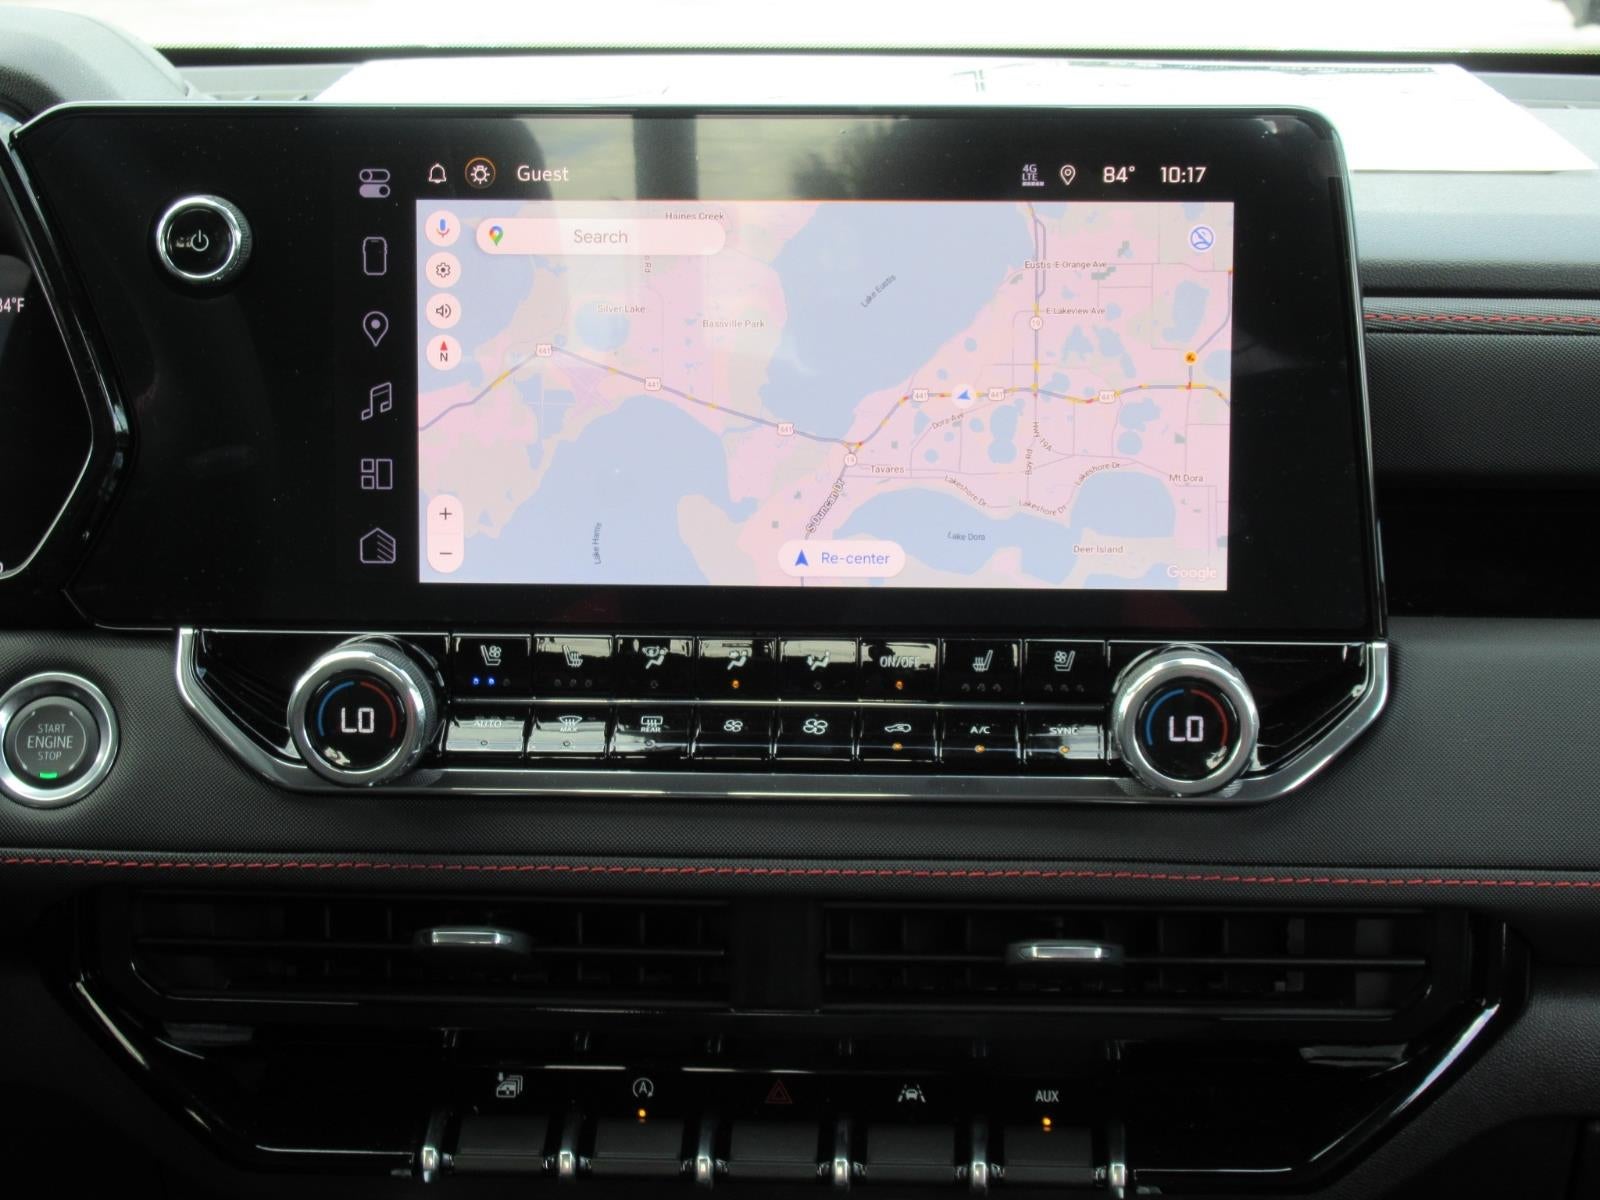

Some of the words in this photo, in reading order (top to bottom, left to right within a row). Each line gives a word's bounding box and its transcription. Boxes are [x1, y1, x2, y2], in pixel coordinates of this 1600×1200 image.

[516, 165, 569, 183] Guest
[1022, 164, 1037, 173] 4G
[1022, 173, 1038, 181] LTE
[1103, 166, 1136, 183] 84°
[1159, 166, 1207, 183] 10:17
[665, 212, 697, 220] Haines
[699, 212, 725, 220] Creek
[573, 229, 629, 245] Search
[1024, 260, 1052, 269] Eustis
[1062, 261, 1091, 270] Orange
[597, 304, 623, 313] Silver
[624, 304, 646, 313] Lake
[1053, 306, 1089, 315] Lakeview
[745, 319, 765, 328] Park
[439, 351, 449, 363] N
[912, 390, 929, 400] 441
[989, 389, 1005, 400] 441
[1099, 391, 1115, 401] 441
[870, 464, 905, 474] Tavares
[1074, 463, 1110, 486] Lakeshore
[1111, 461, 1121, 469] Dr
[1169, 473, 1180, 483] Mt
[1181, 473, 1204, 483] Dora
[944, 474, 979, 502] Lakeshore
[977, 497, 988, 507] Dr
[1019, 499, 1057, 516] Lakeshore
[947, 530, 967, 541] Lake
[967, 532, 986, 541] Dora
[1073, 544, 1094, 554] Deer
[1096, 544, 1124, 554] Island
[820, 551, 891, 566] Re-center
[1167, 565, 1217, 581] Google
[879, 655, 920, 669] ON/OFF
[340, 706, 375, 734] LO
[473, 719, 503, 729] AUTO
[37, 723, 66, 734] START
[640, 726, 661, 734] REAR
[970, 725, 991, 735] A/C
[1048, 726, 1079, 736] SYNC
[1168, 715, 1204, 743] LO
[26, 734, 74, 751] ENGINE
[37, 751, 62, 762] STOP
[1035, 1089, 1060, 1103] AUX
